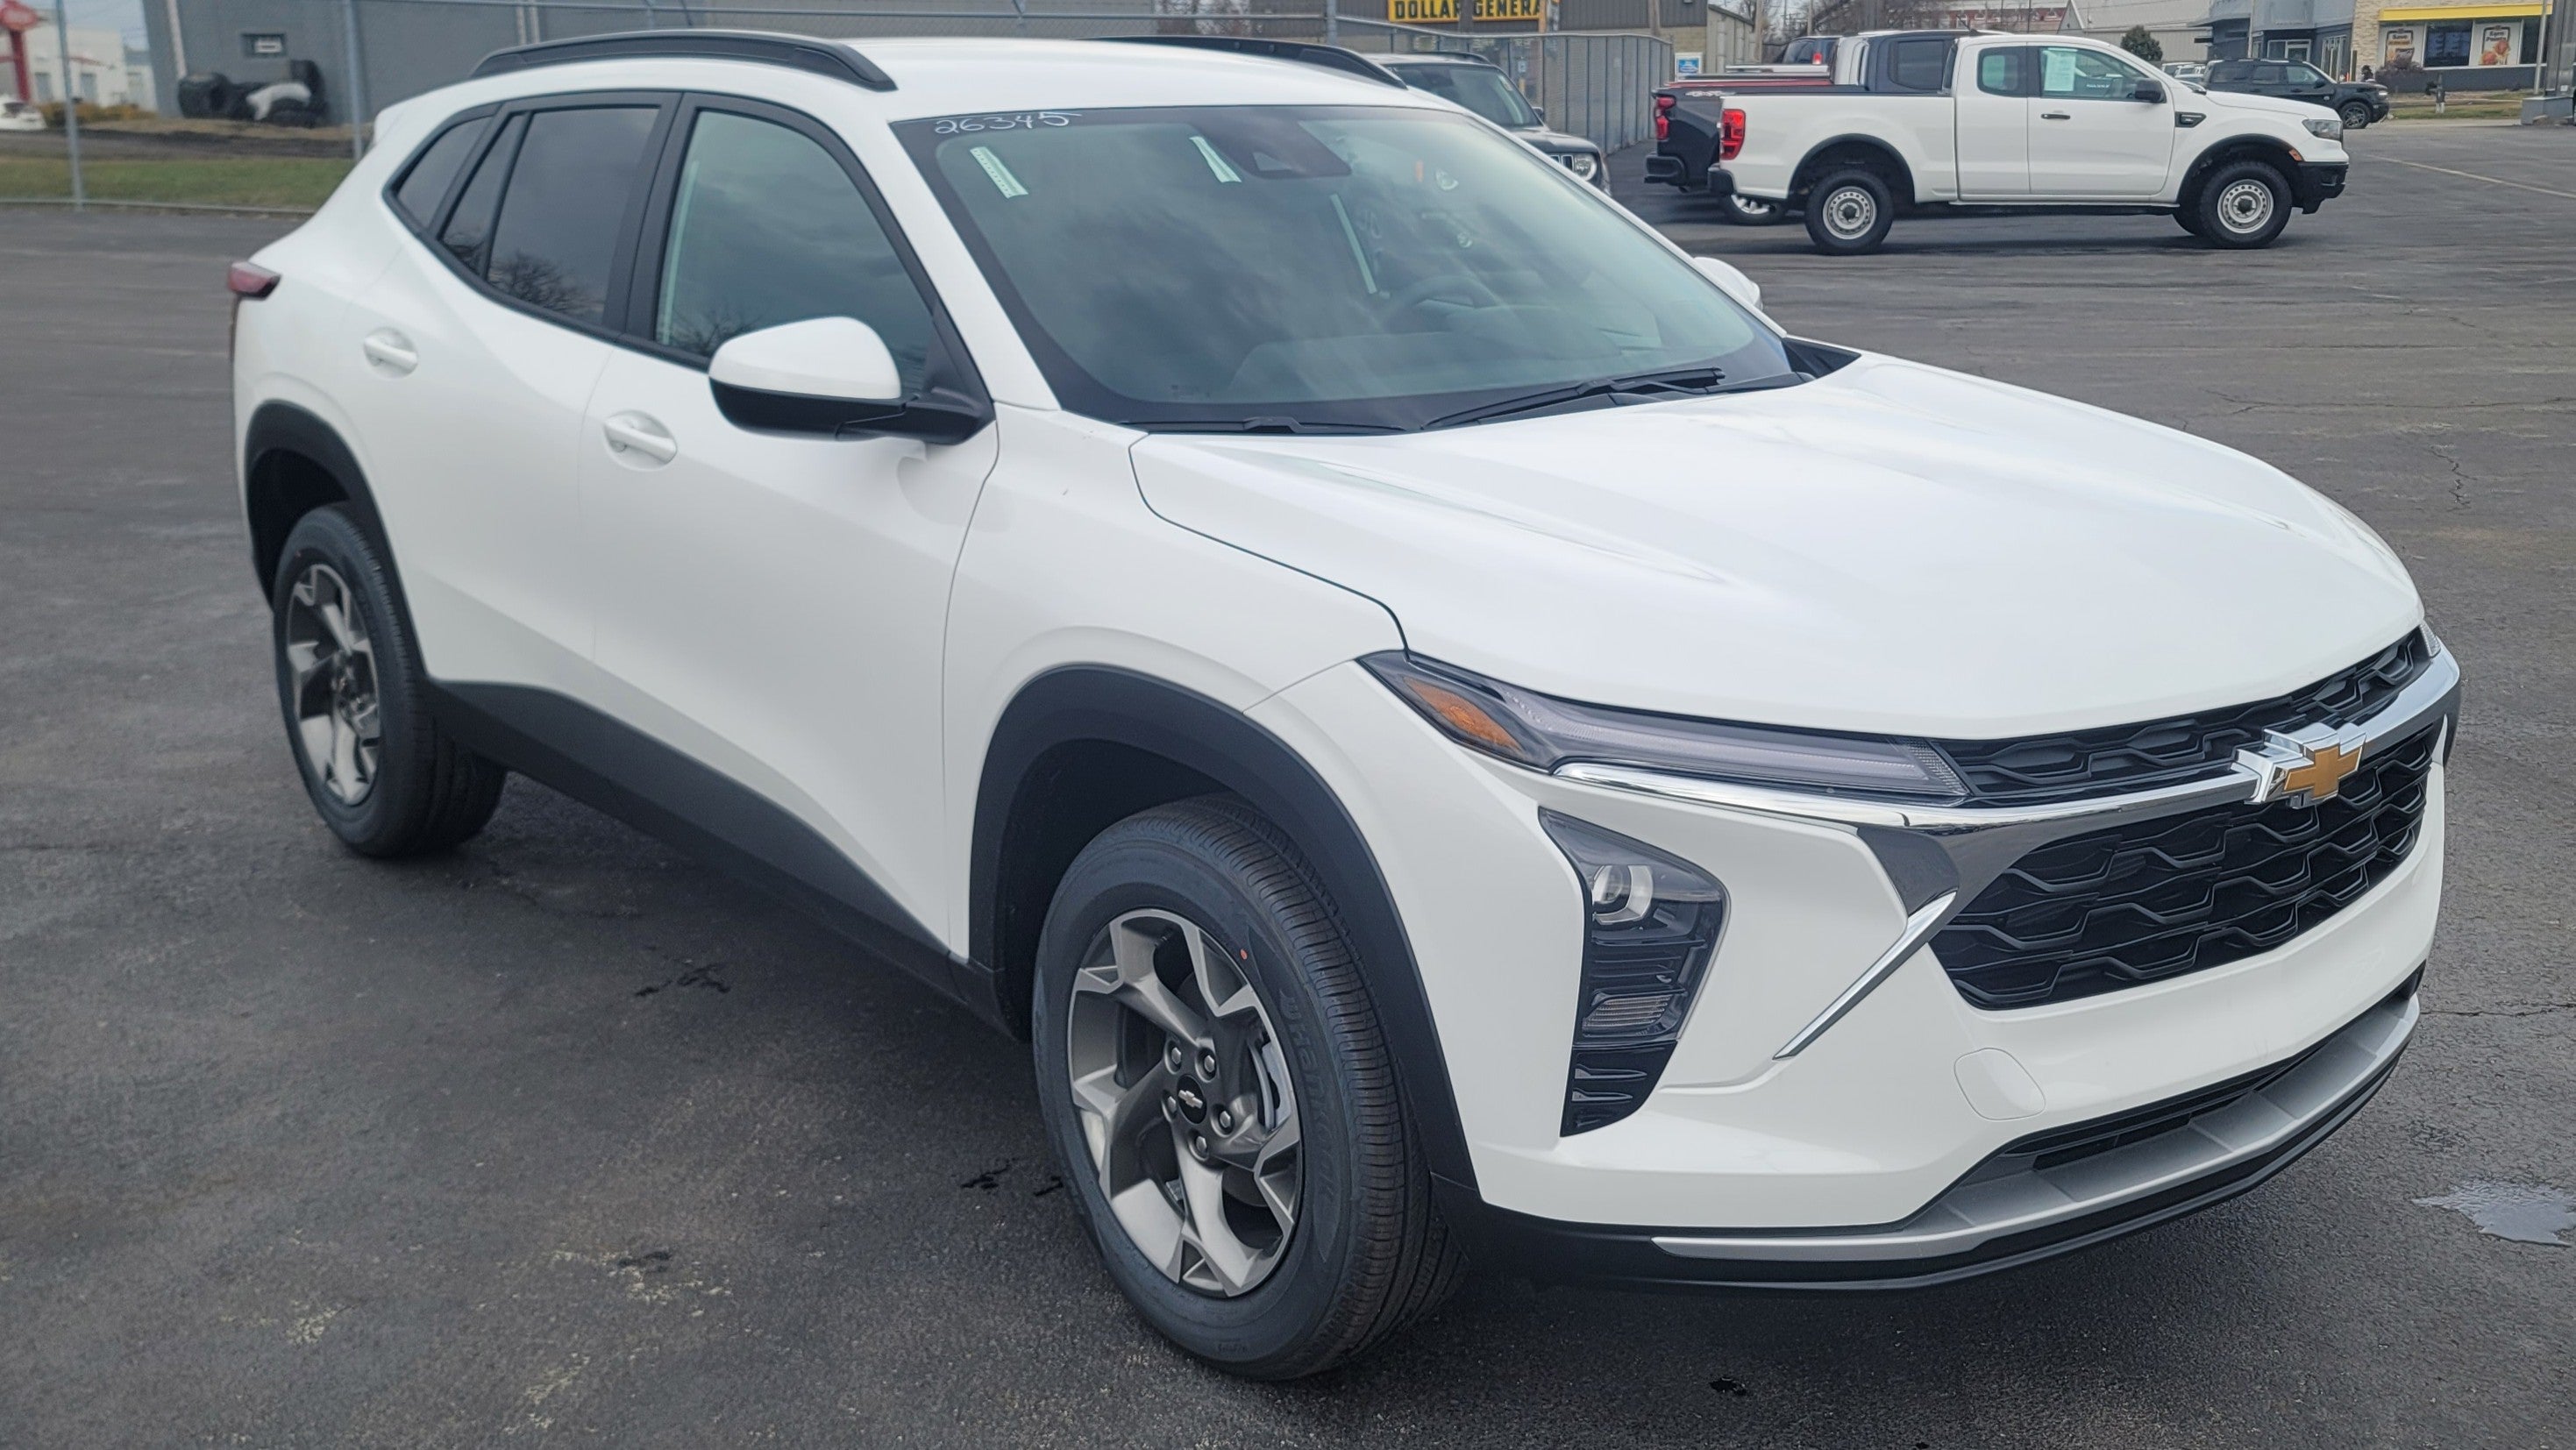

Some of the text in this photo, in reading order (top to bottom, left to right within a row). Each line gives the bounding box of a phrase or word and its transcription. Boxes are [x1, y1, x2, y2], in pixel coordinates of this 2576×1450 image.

[1394, 0, 1540, 18] DOLLAR GENERA
[935, 112, 1082, 134] 26345
